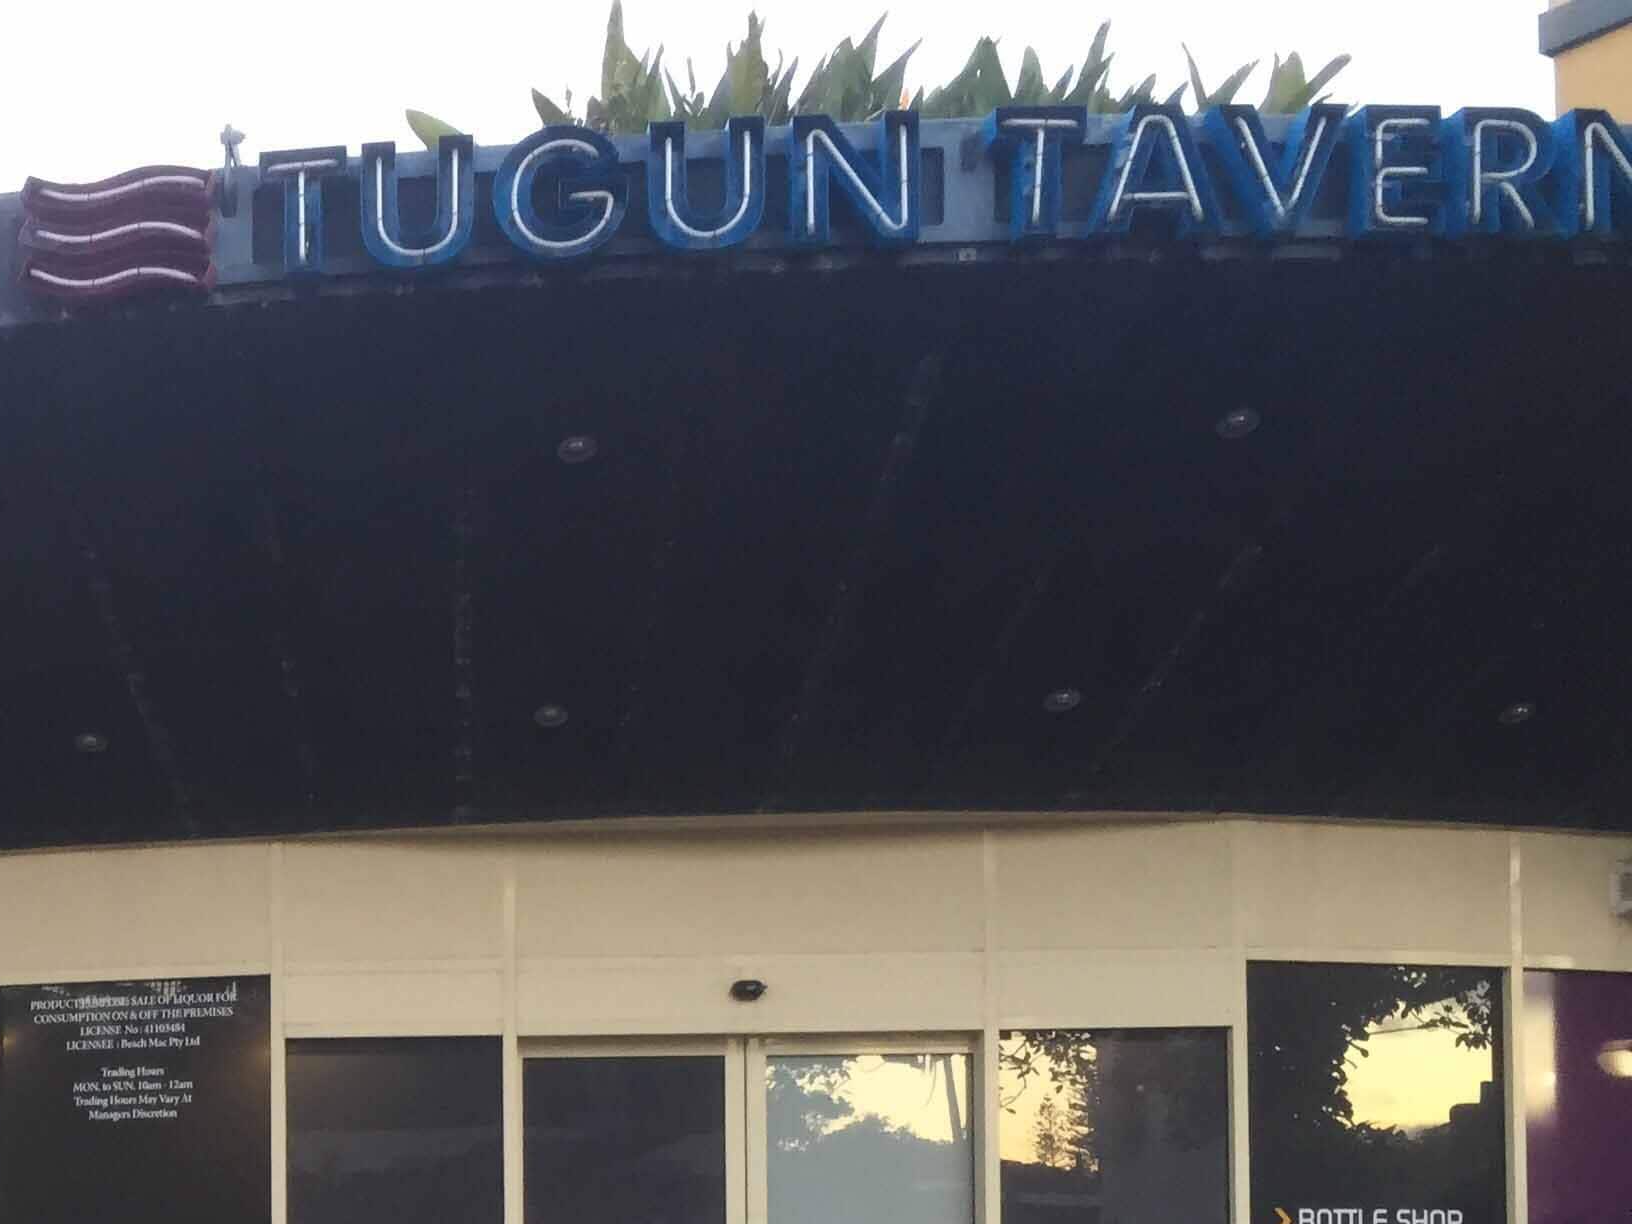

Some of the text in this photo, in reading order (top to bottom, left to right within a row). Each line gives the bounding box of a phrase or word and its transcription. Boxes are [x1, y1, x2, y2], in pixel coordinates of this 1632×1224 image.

[258, 103, 1632, 274] TUGUN TAVERN
[131, 995, 156, 1006] SALE
[172, 992, 215, 1006] LIQUOR
[216, 990, 238, 1002] FOR
[33, 1012, 110, 1024] CONSUMPTION
[111, 1010, 128, 1020] ON
[138, 1009, 159, 1019] OFF
[161, 1008, 183, 1018] THE
[183, 1006, 234, 1018] PREMISES
[80, 1025, 121, 1036] LICENSE
[66, 1039, 114, 1051] LICENSEE
[168, 1036, 184, 1049] Pty
[184, 1035, 200, 1046] Ltd
[101, 1066, 165, 1079] Trading Hours
[137, 1080, 162, 1091] 10am
[168, 1080, 193, 1090] 12am
[74, 1096, 109, 1108] Trading
[109, 1095, 137, 1106] Hours
[138, 1095, 158, 1105] May
[158, 1094, 181, 1106] Vary
[88, 1107, 178, 1122] Managers Discretion
